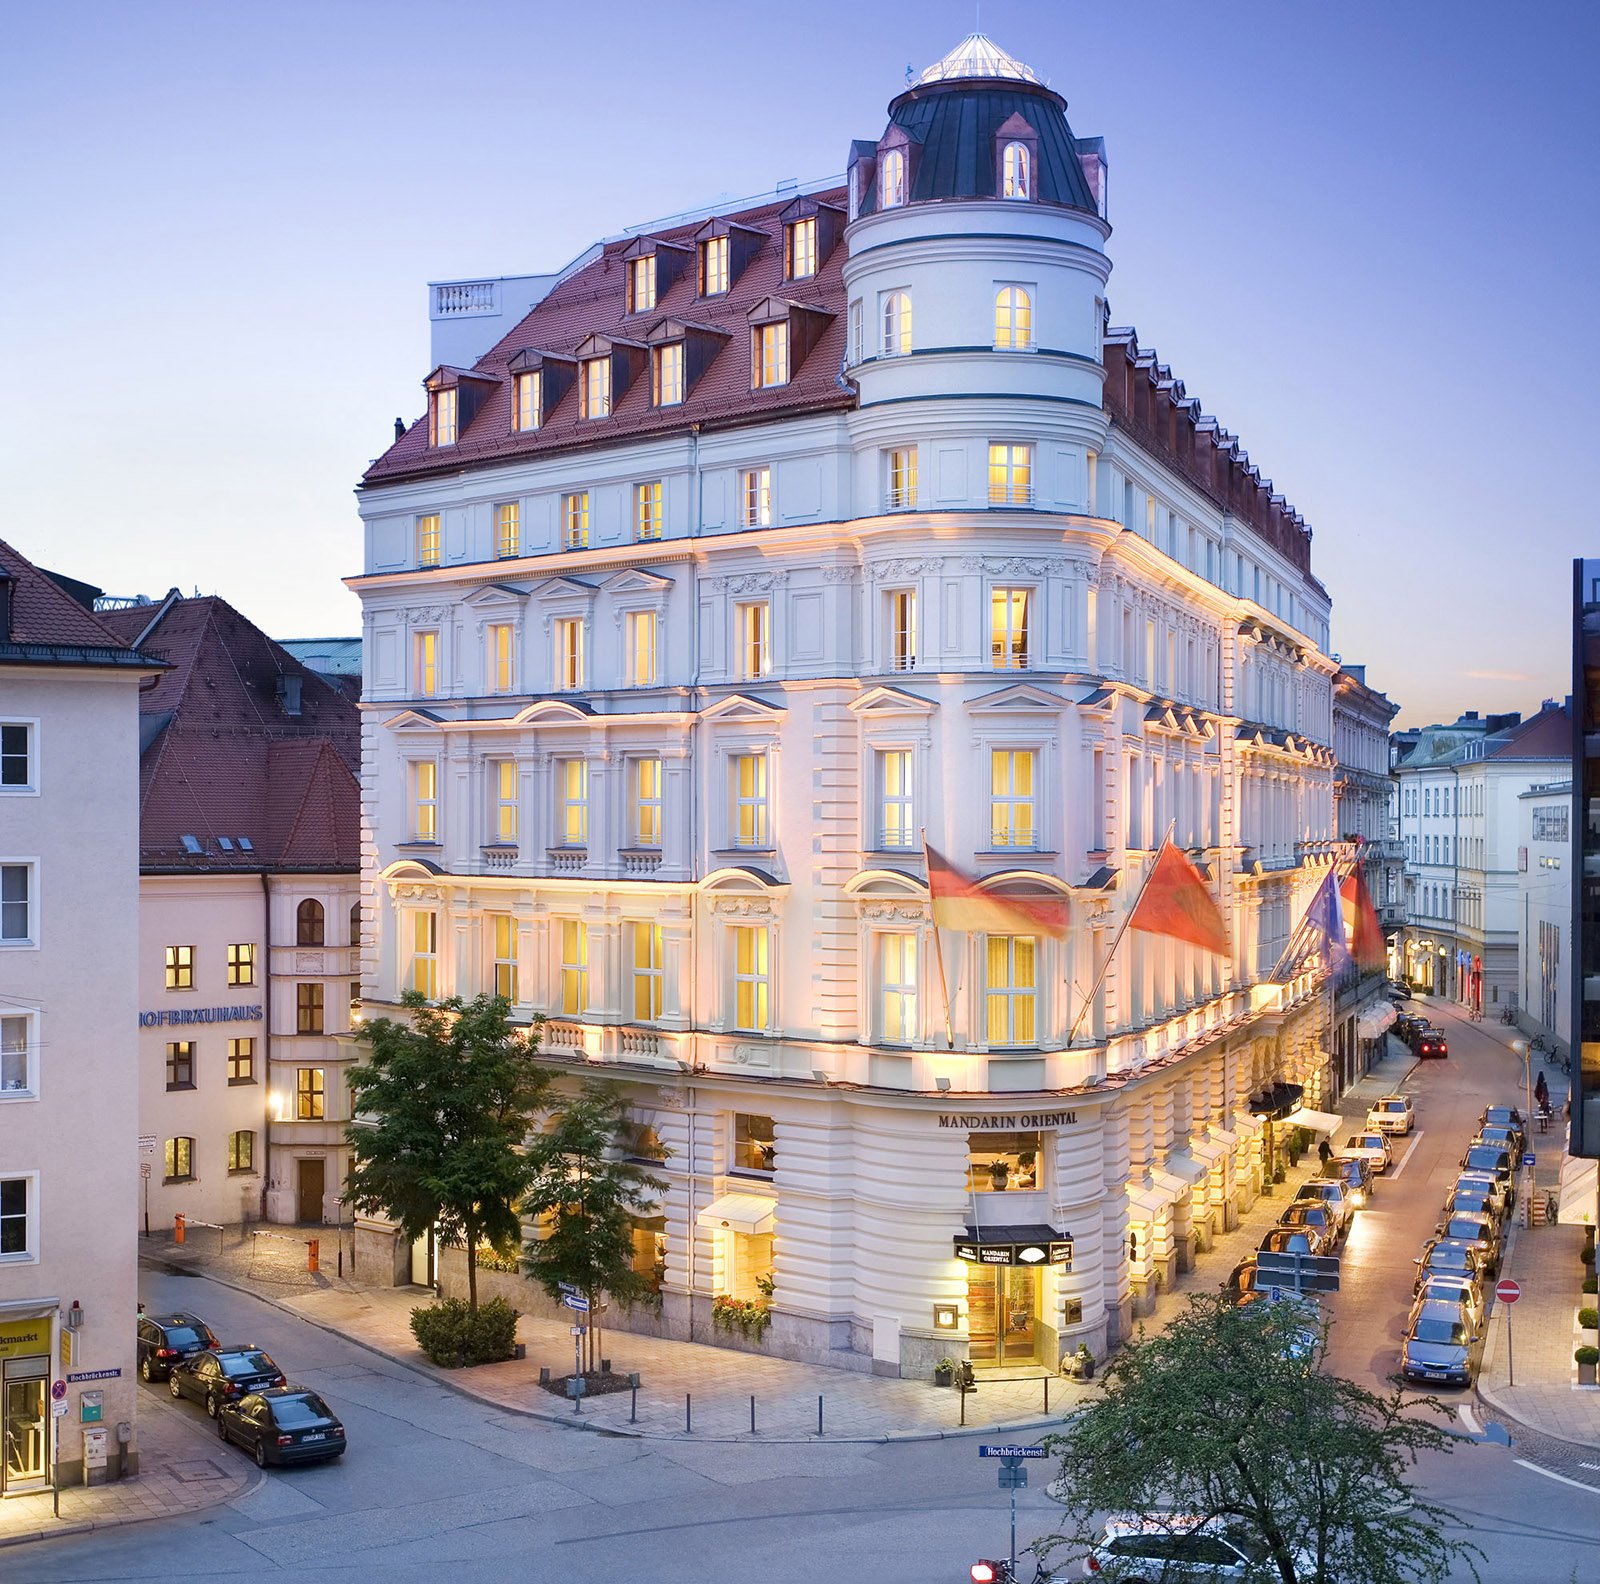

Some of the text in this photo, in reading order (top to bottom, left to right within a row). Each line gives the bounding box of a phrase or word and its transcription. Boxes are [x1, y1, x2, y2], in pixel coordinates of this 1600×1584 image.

[938, 1112, 1078, 1129] MANDARIN ORIENTAL
[981, 1249, 1010, 1258] MANDARIN
[983, 1255, 1010, 1263] ORIENTAL
